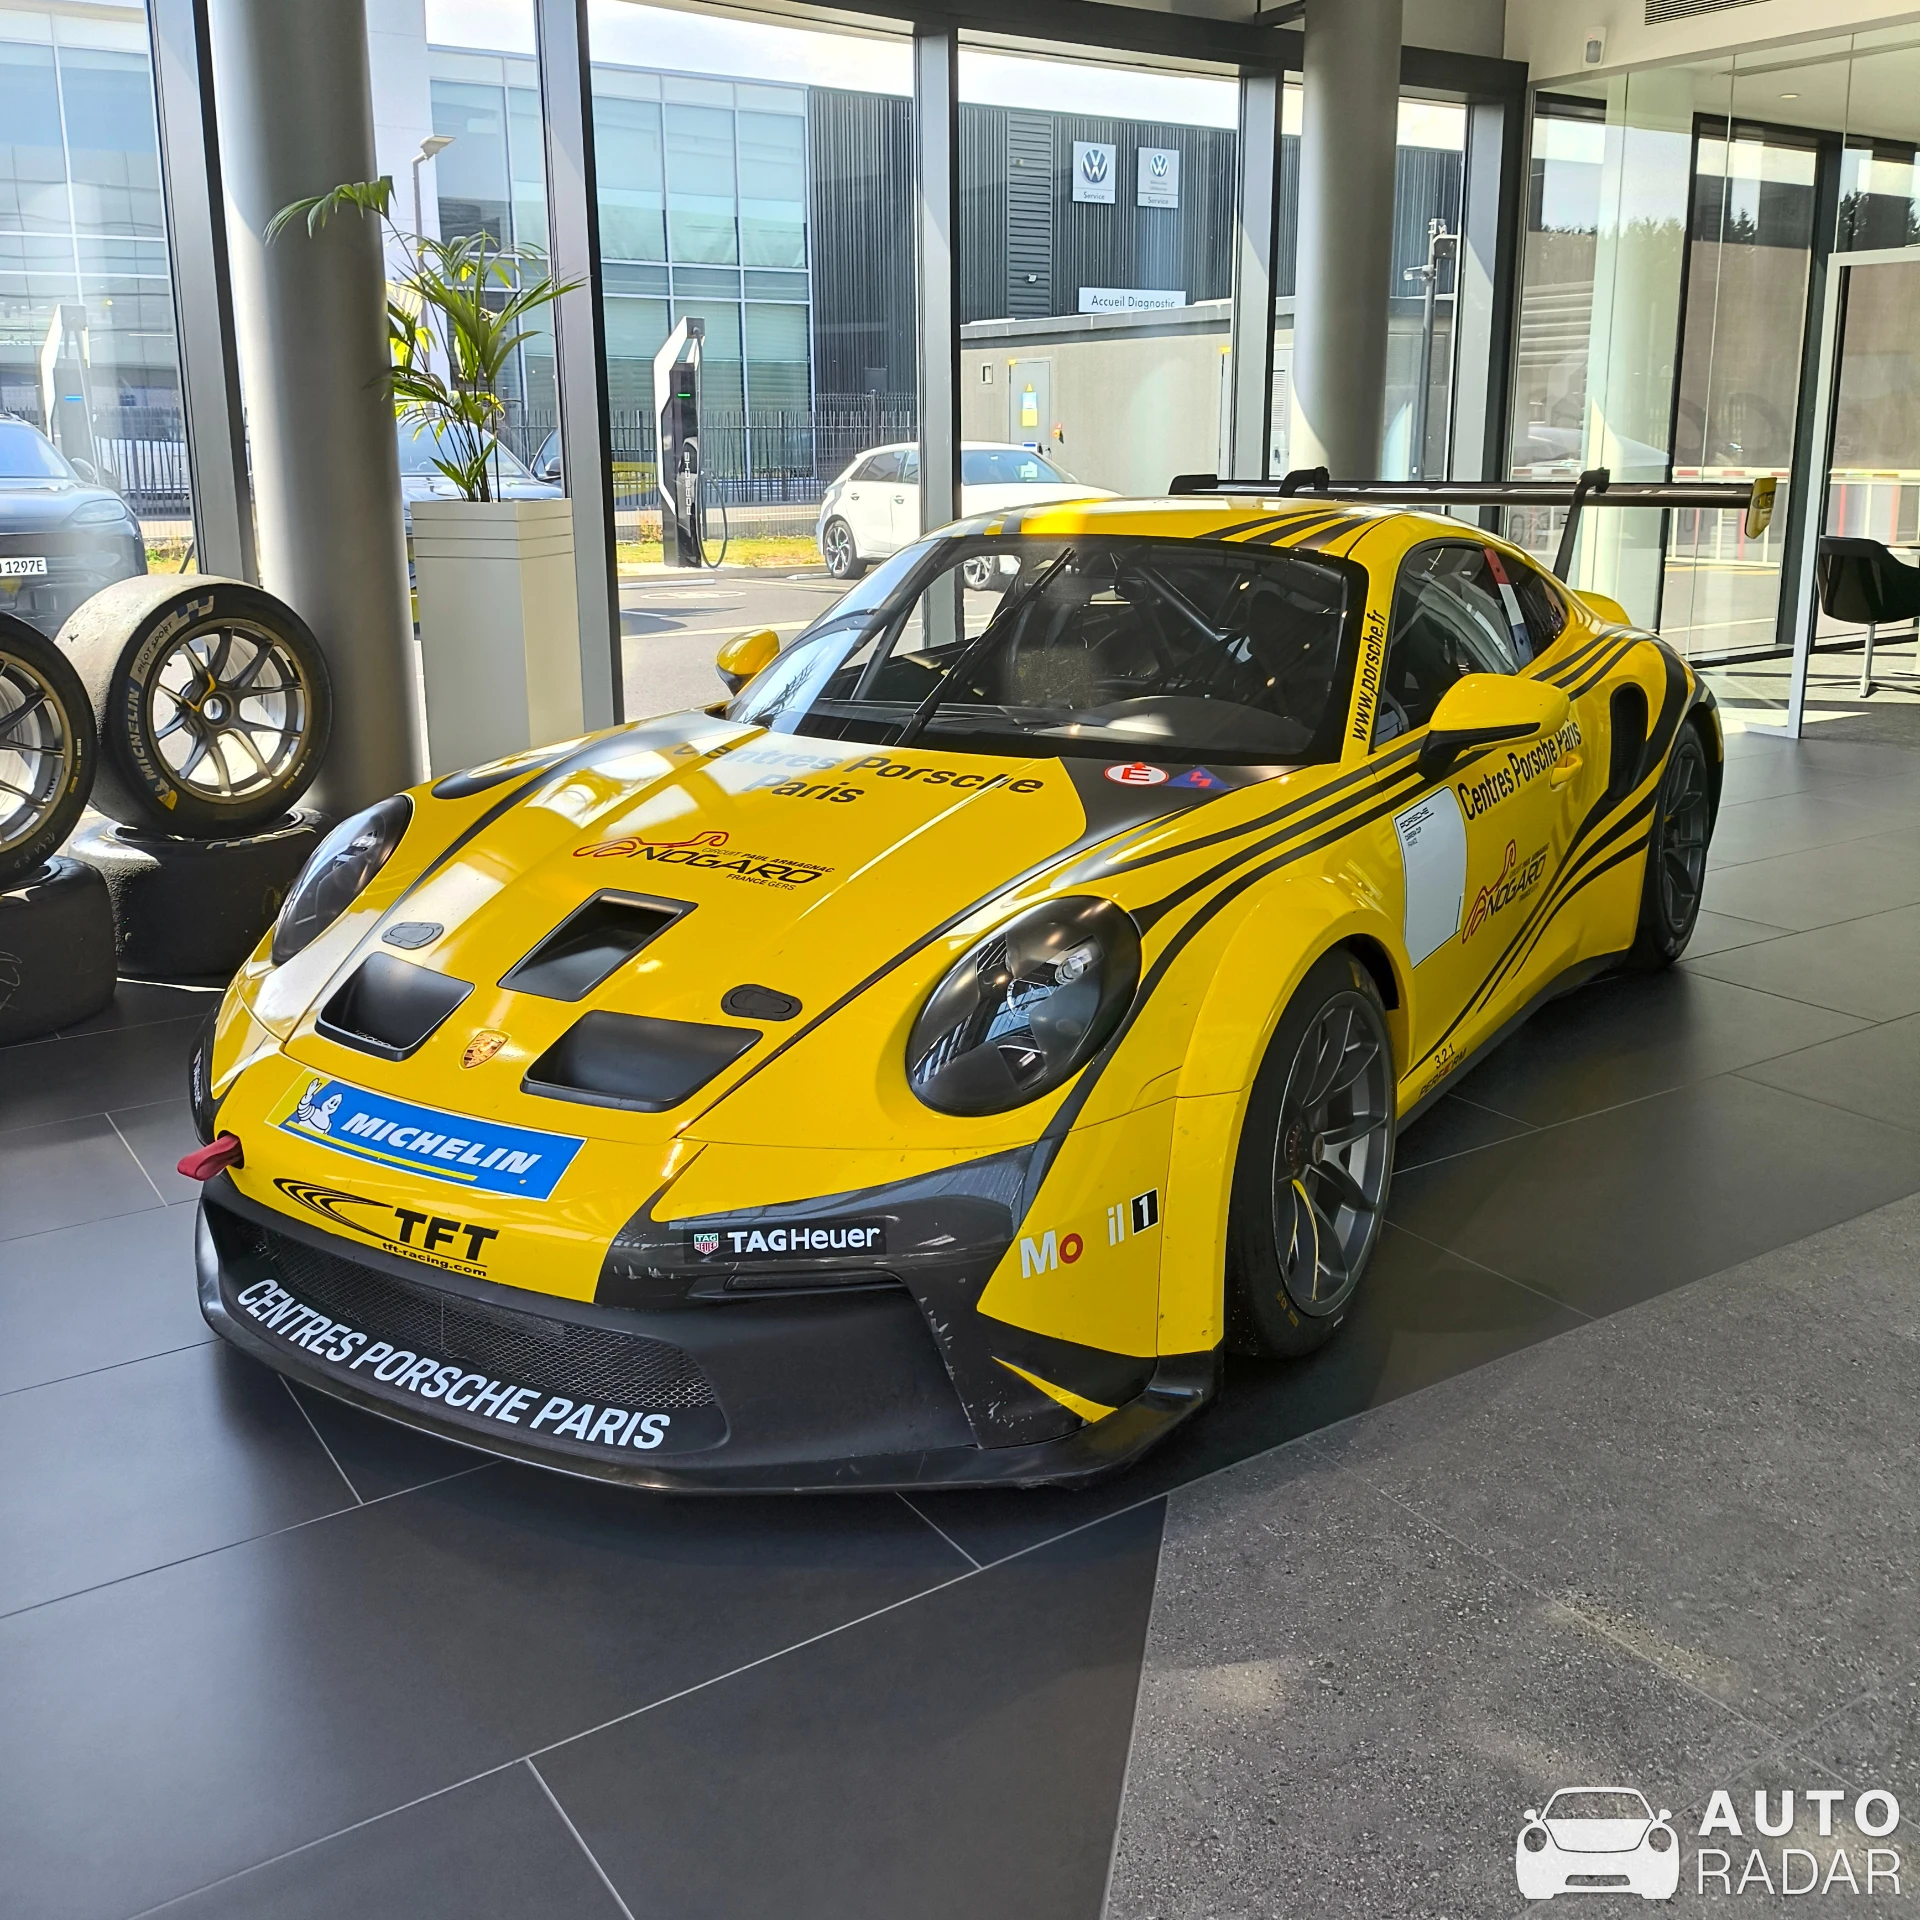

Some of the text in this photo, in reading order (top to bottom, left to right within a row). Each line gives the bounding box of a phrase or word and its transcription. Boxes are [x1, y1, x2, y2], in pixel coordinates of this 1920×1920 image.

[1083, 191, 1105, 200] Service
[1147, 197, 1169, 205] Service
[1091, 295, 1175, 310] Accueil Diagnostic
[683, 451, 692, 516] PORSCHE
[137, 621, 173, 675] PILOT SPORT
[1352, 609, 1386, 742] www.porsche.fr
[127, 687, 157, 781] MICHELIN
[741, 773, 866, 804] Paris
[843, 756, 1044, 794] Porsche
[1457, 773, 1515, 821] Centres
[1507, 738, 1558, 788] Porsche
[627, 846, 823, 884] NOGARO
[701, 847, 836, 873] CIRCUIT PAUL ARMAGNAC
[726, 873, 797, 891] FRANCE GERS
[1484, 854, 1547, 922] NOGARO
[340, 1112, 542, 1174] MICHELIN
[394, 1207, 500, 1262] TFT
[382, 1242, 487, 1277] tft-racing.com
[237, 1279, 671, 1450] CENTRES PORSCHE PARIS
